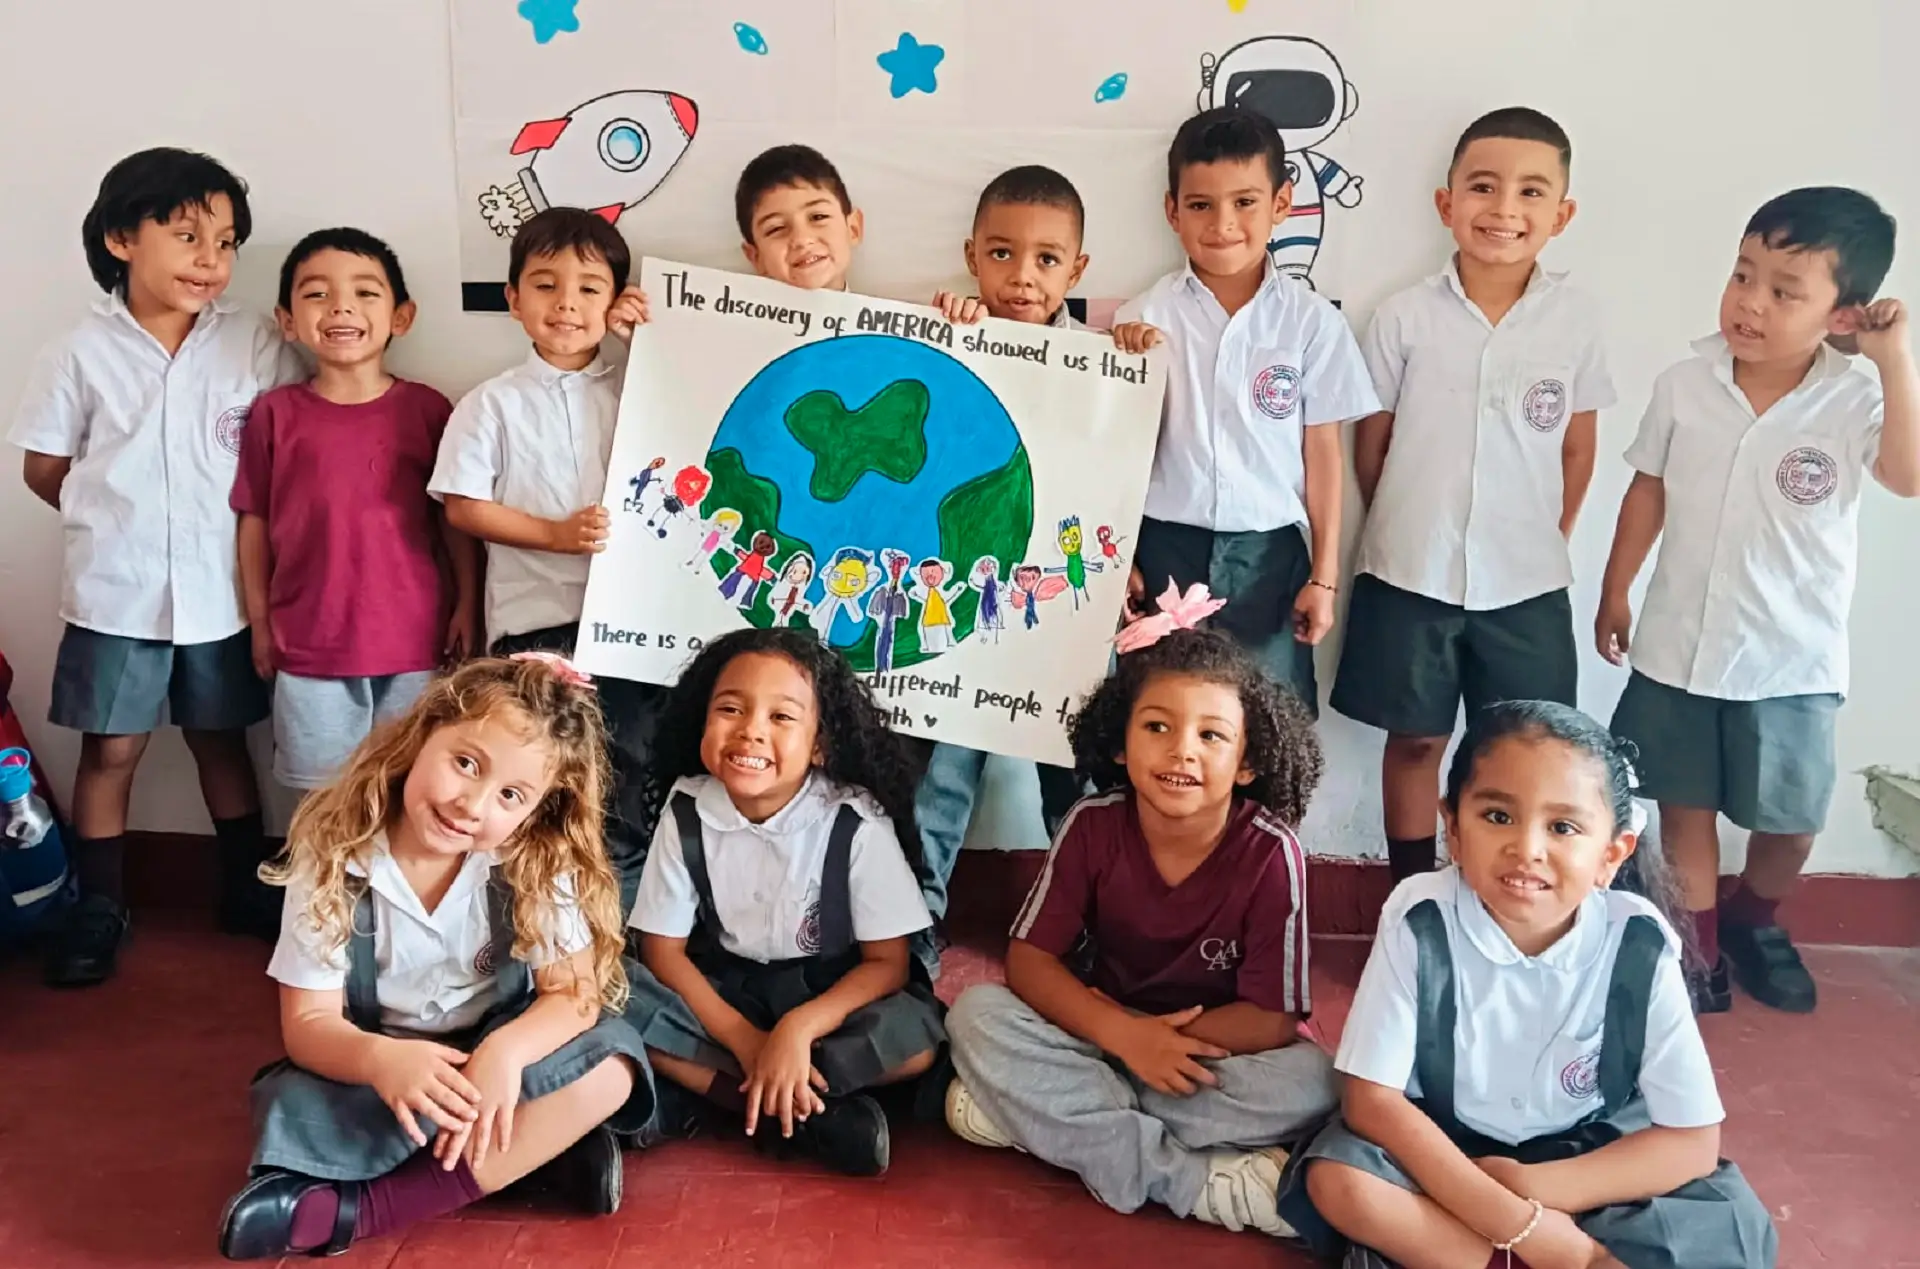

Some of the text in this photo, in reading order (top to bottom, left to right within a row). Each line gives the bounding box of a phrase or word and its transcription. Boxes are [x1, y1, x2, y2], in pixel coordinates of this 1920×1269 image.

[661, 270, 1149, 385] The discovery of AMERICA showed us that
[591, 621, 647, 647] There
[865, 667, 963, 698] different
[973, 687, 1042, 723] people
